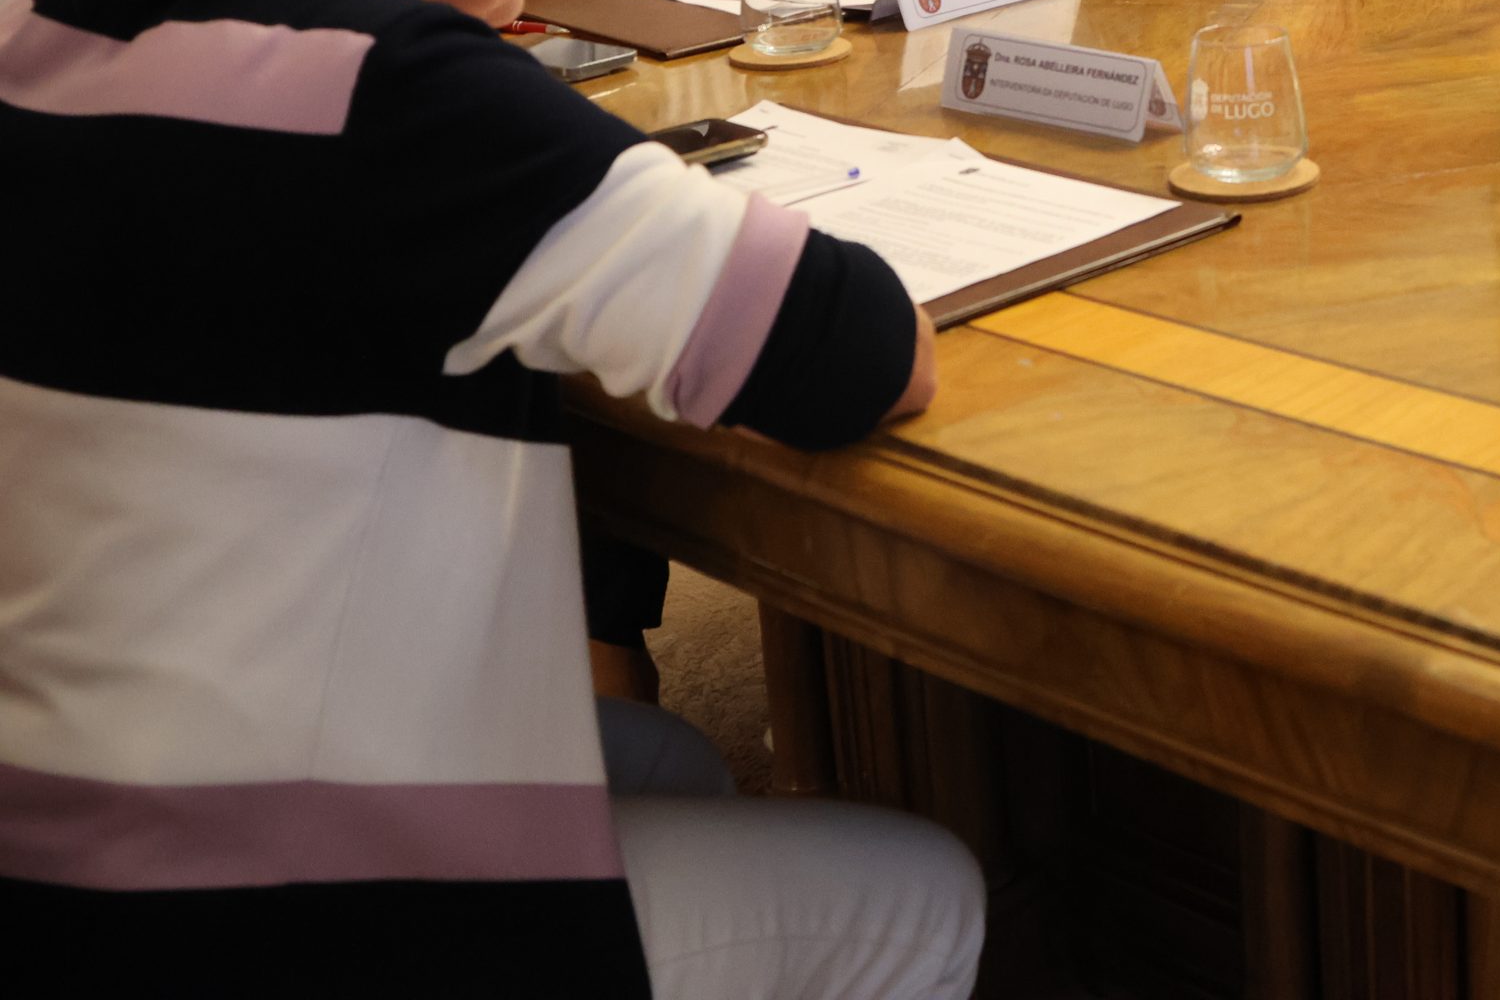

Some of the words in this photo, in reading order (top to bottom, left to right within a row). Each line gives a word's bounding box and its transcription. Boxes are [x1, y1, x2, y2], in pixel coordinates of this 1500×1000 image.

[1014, 55, 1038, 69] ROSA
[1039, 58, 1085, 78] ABELLEIRA
[1086, 65, 1139, 86] FERNÁNDEZ
[1112, 98, 1133, 111] LUGO
[1224, 102, 1275, 120] LUGO
